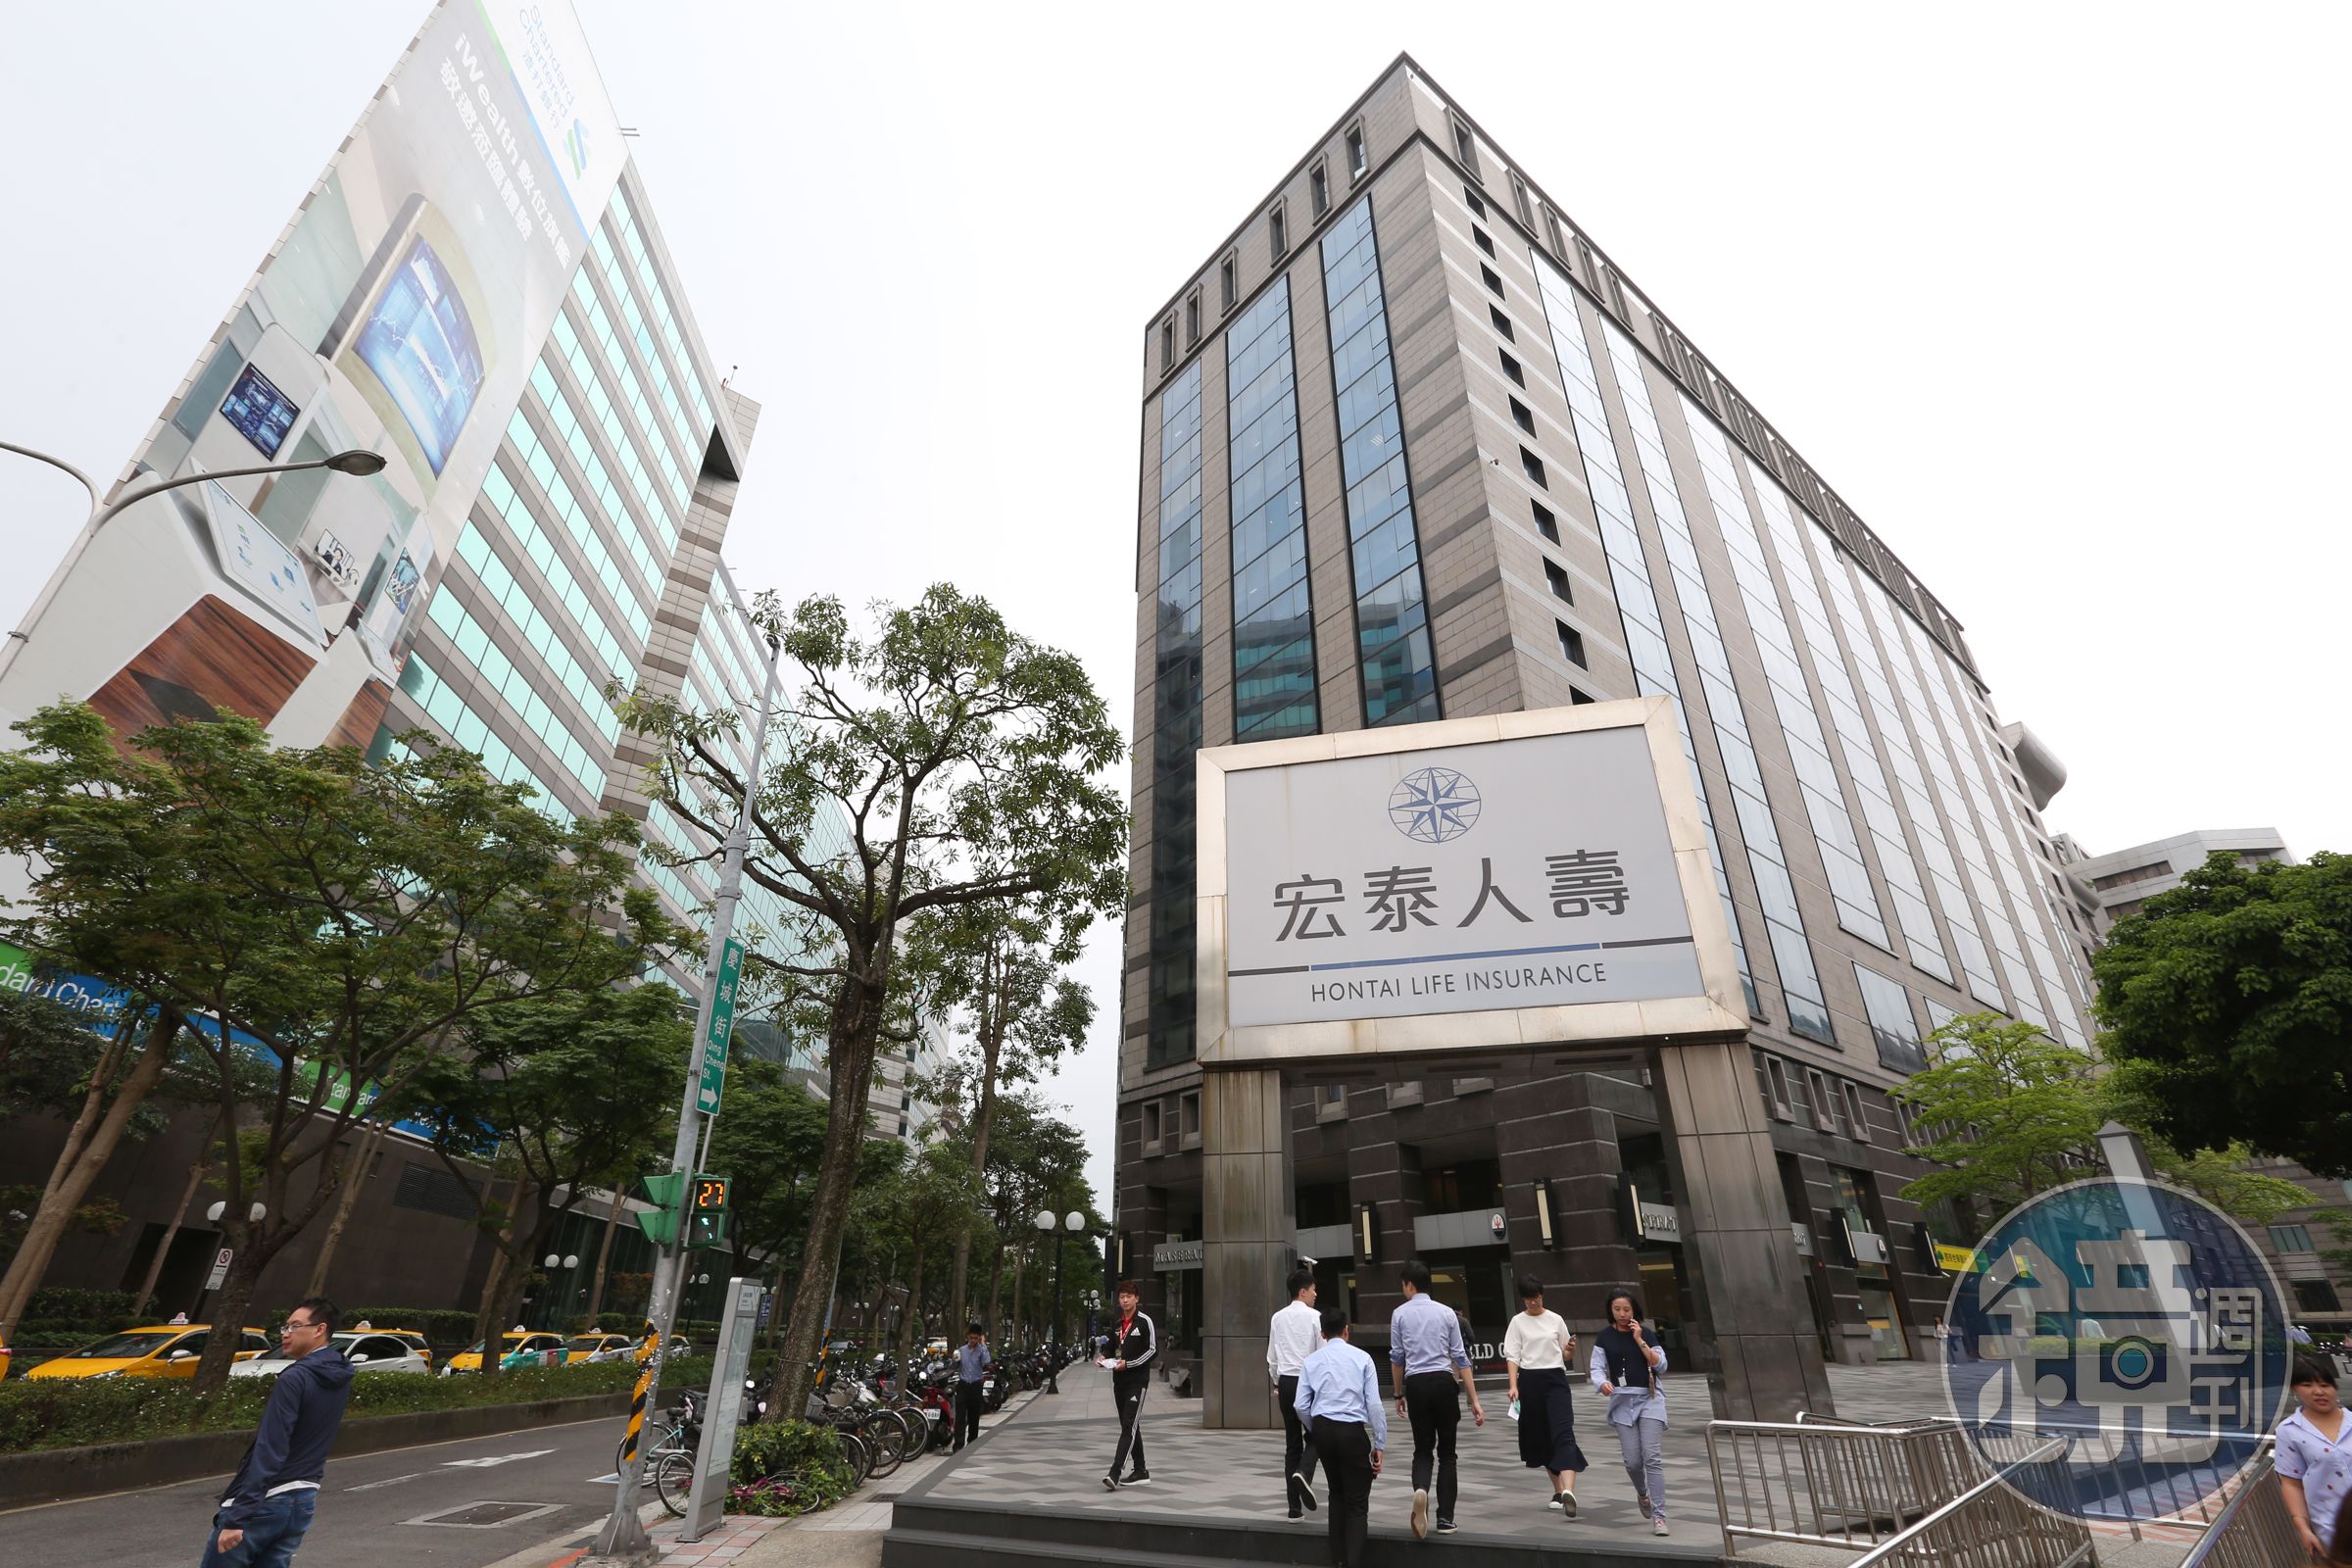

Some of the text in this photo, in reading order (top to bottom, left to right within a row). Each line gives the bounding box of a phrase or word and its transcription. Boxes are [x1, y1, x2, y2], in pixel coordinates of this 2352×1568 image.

[454, 32, 519, 166] iWealth
[518, 8, 569, 118] Chartered
[530, 4, 576, 106] Standard
[1273, 849, 1631, 943] 宏泰人壽
[714, 947, 740, 1038] 慶城街
[1311, 962, 1607, 1003] HONTAI LIFE INSURANCE
[705, 1054, 724, 1073] Cheng
[707, 1040, 722, 1056] Qing
[699, 1183, 724, 1207] 27
